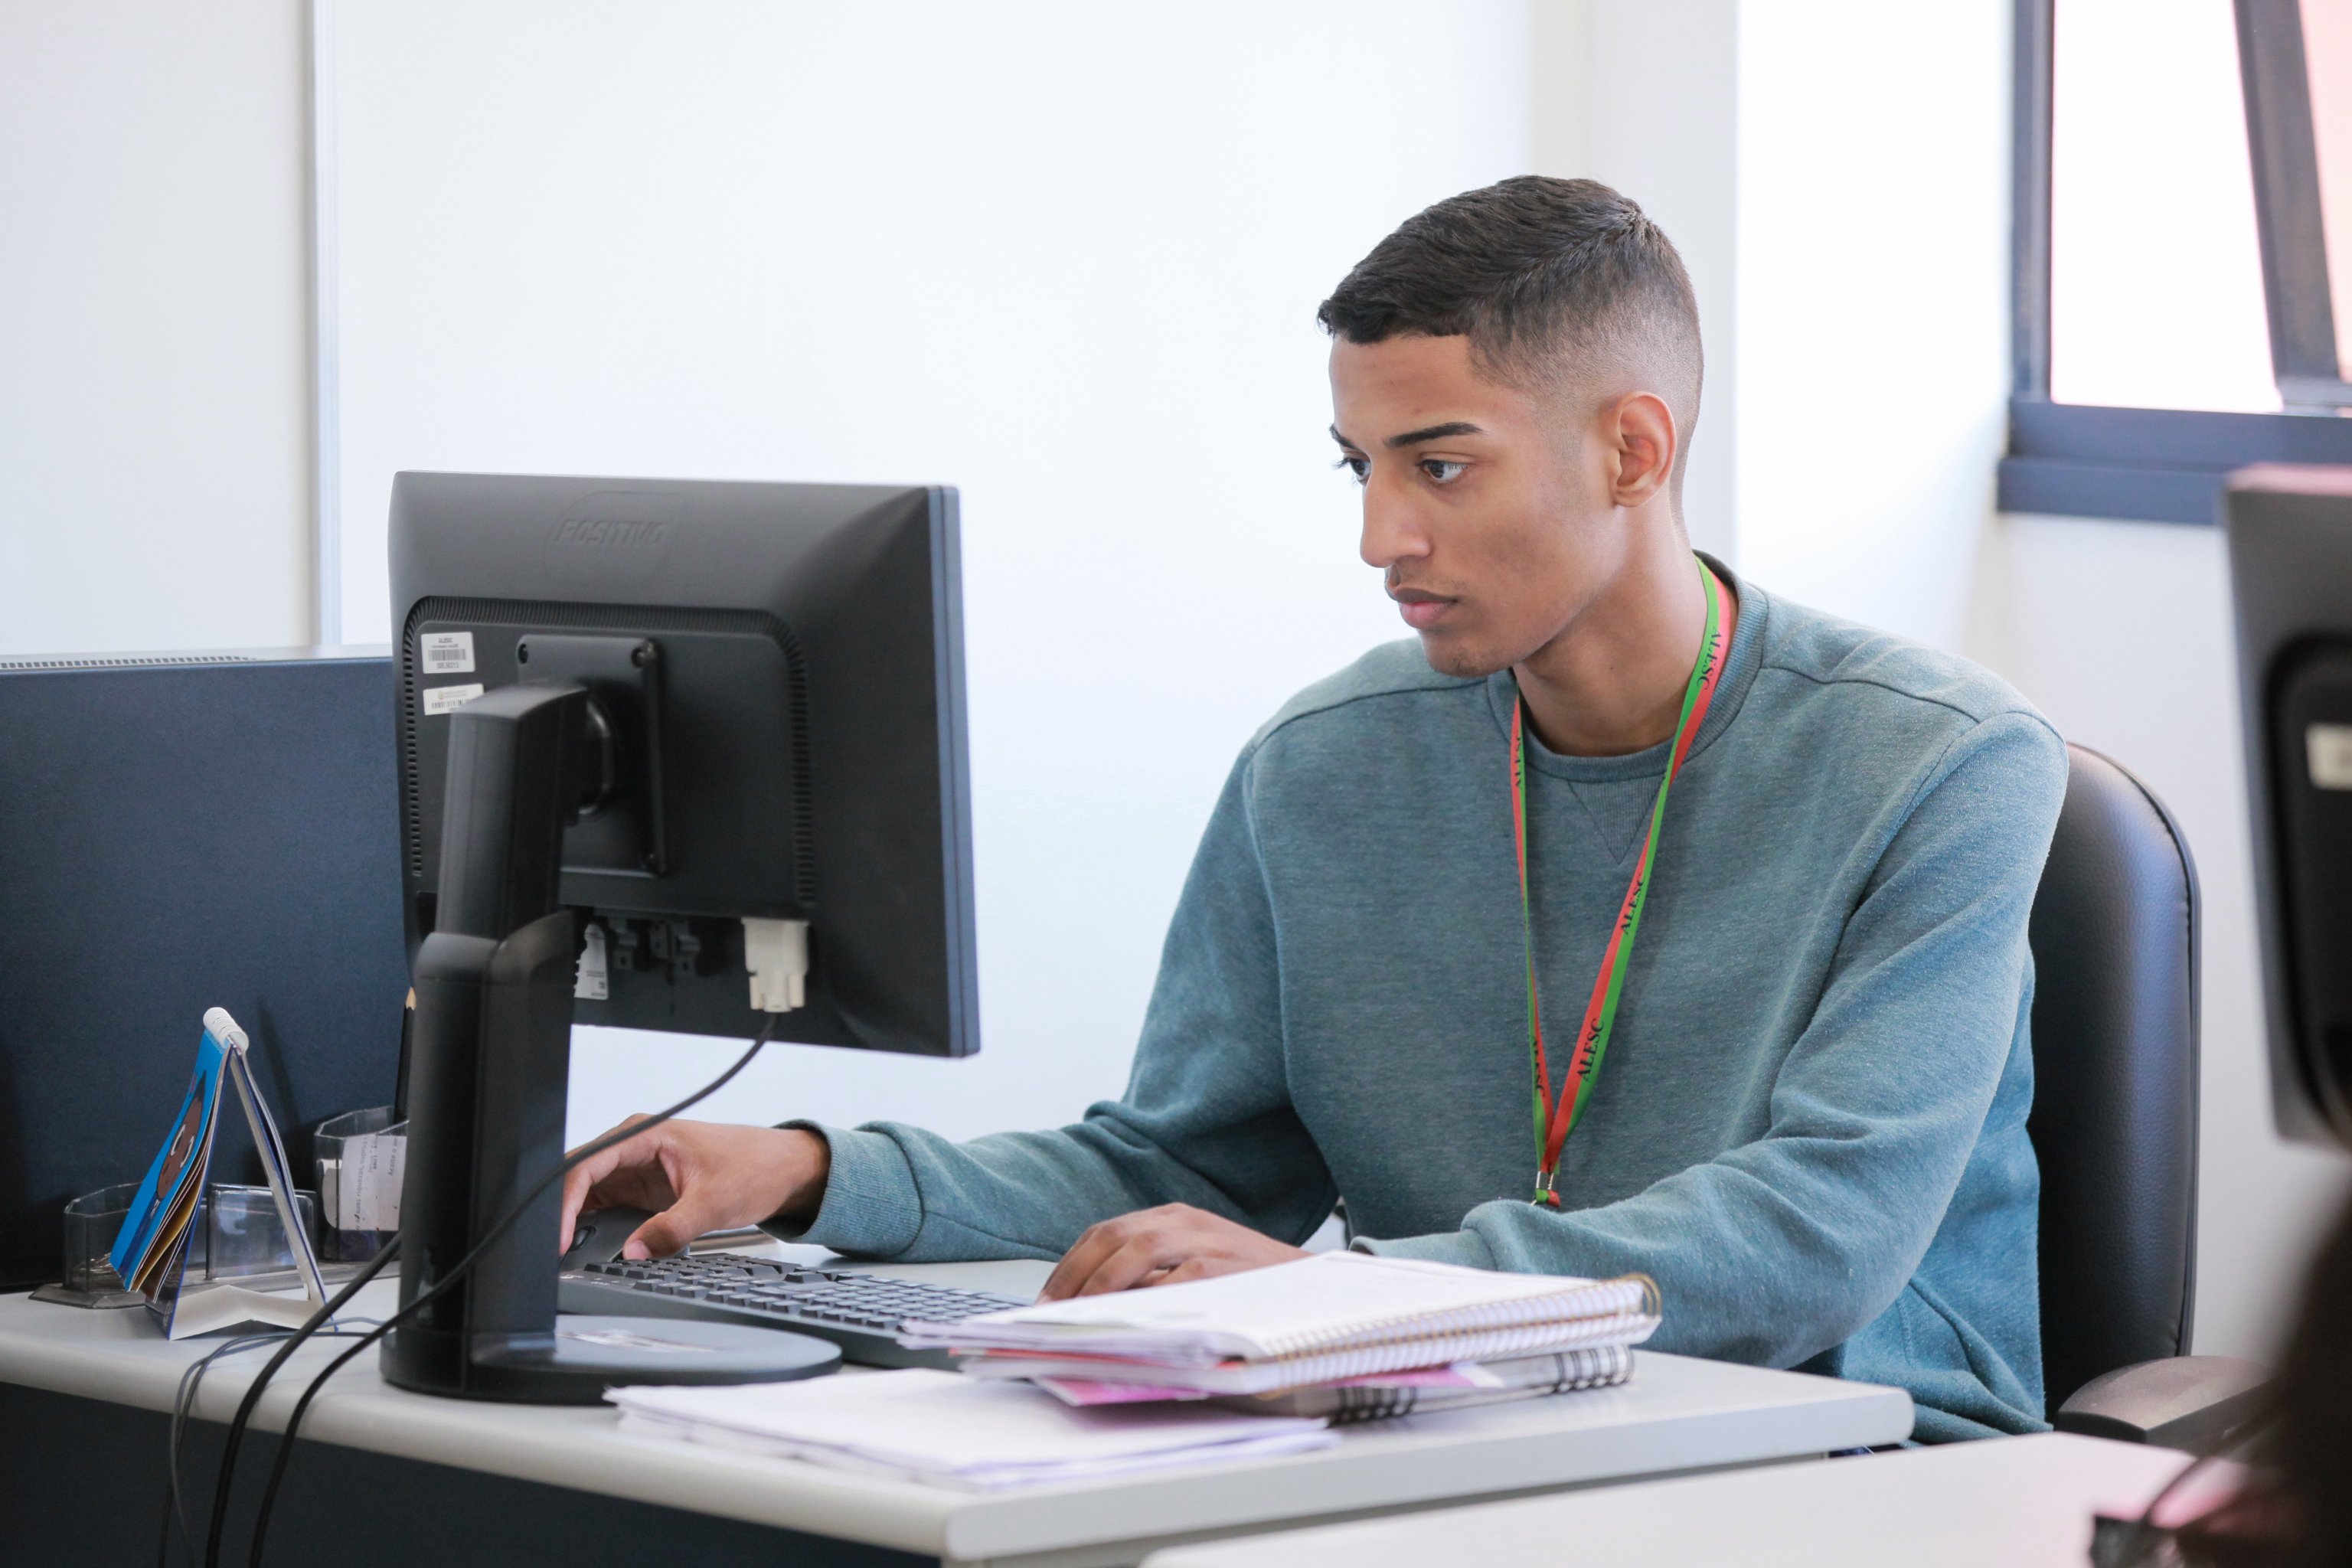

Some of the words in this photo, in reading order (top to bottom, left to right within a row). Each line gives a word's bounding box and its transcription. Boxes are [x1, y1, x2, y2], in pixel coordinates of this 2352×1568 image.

[1696, 626, 1723, 691] ALESC
[1620, 873, 1645, 936] ALESC
[1576, 1018, 1605, 1082] ALESC
